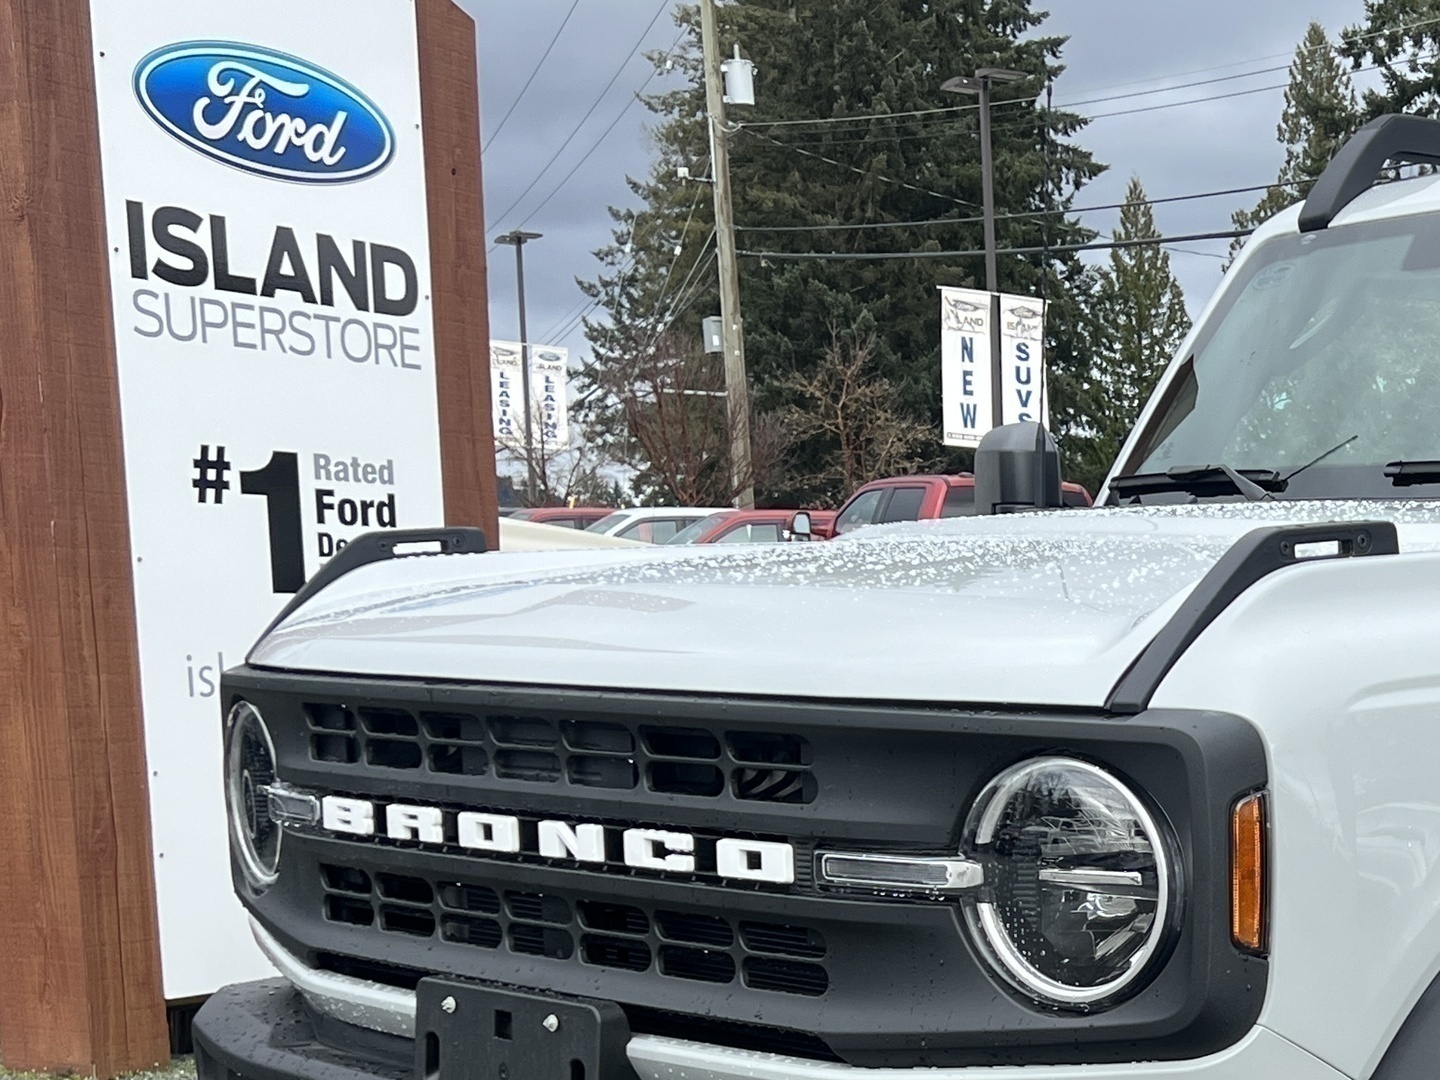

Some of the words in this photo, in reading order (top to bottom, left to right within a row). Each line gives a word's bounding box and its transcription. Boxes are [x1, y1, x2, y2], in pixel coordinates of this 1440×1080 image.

[192, 60, 348, 166] Ford
[125, 199, 418, 317] ISLAND
[133, 288, 421, 370] SUPERSTORE
[499, 371, 512, 435] LEASING
[543, 375, 557, 438] LEASING
[960, 336, 977, 429] NEW
[313, 453, 395, 485] Rated
[315, 488, 397, 528] Ford
[322, 795, 796, 884] BRONCO
